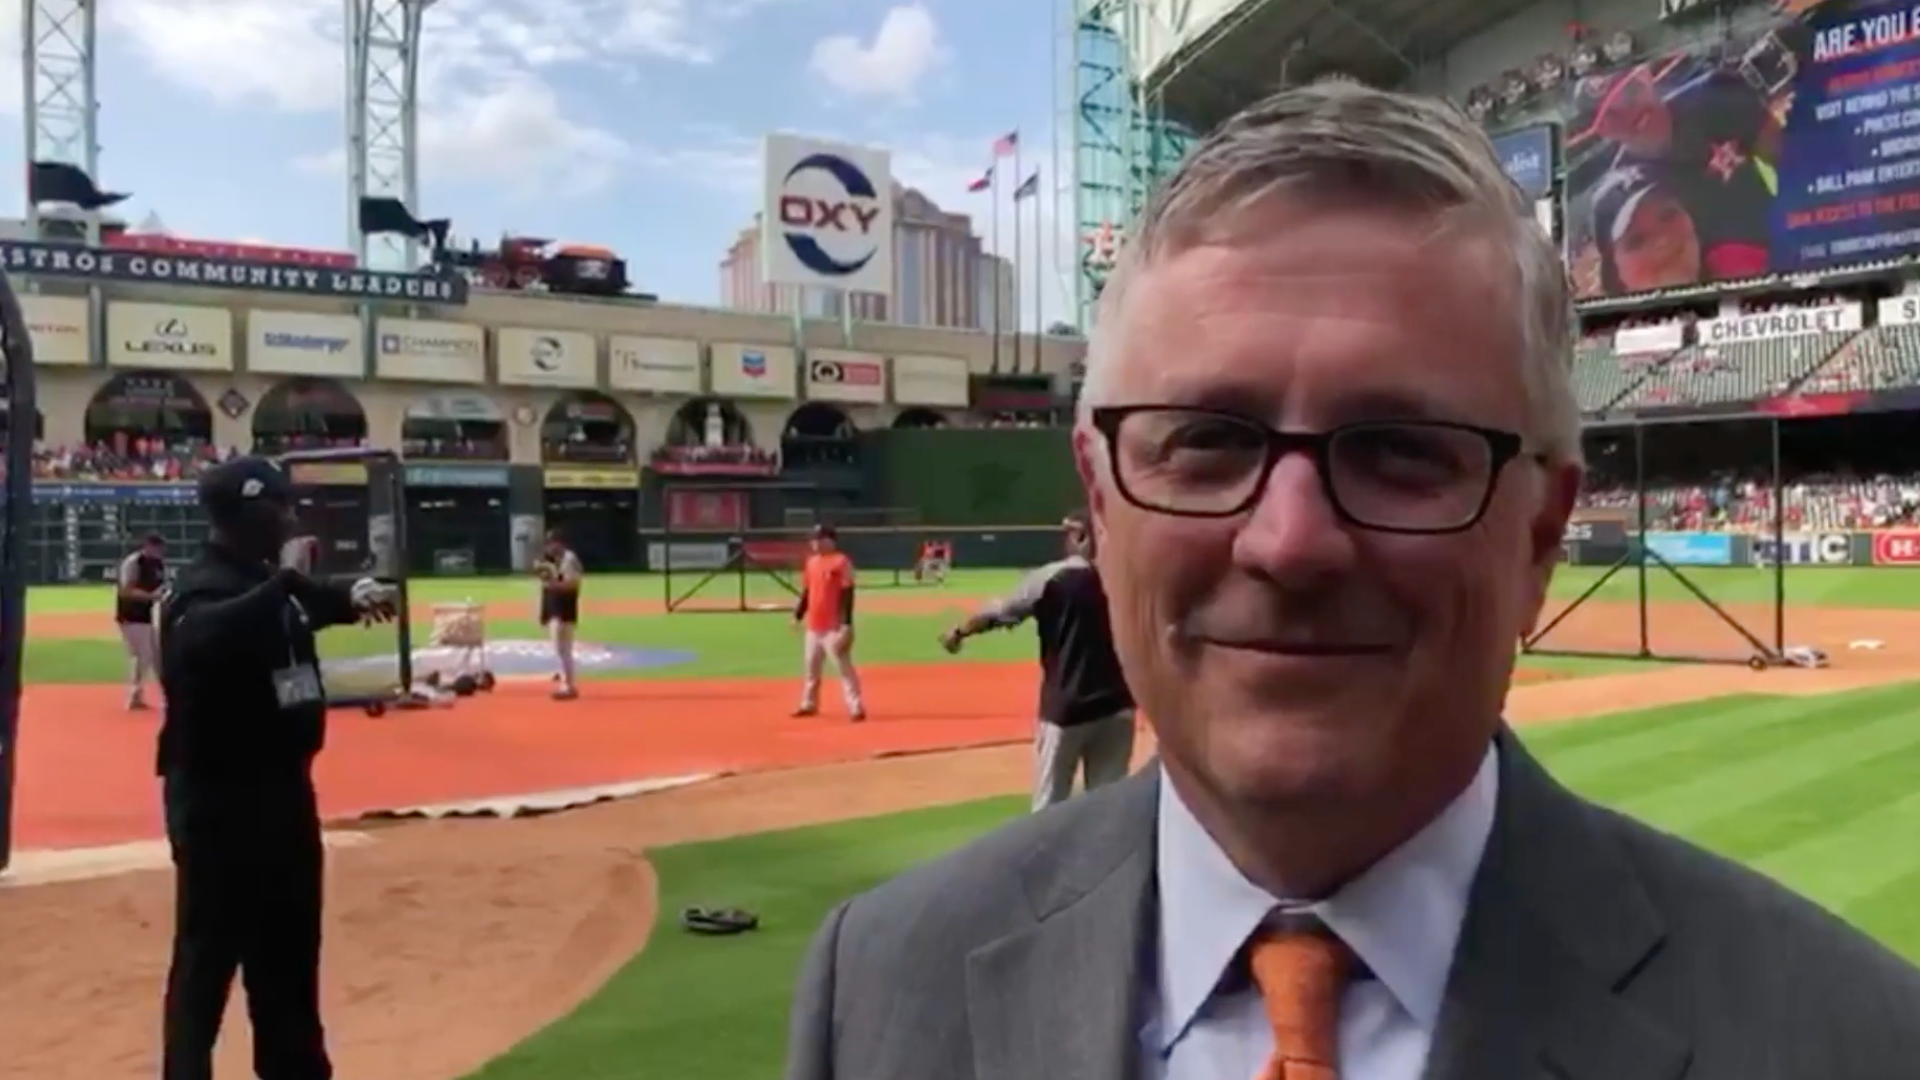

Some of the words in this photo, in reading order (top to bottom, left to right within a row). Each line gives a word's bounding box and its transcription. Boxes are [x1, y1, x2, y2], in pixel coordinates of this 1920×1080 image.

[1813, 22, 1857, 62] ARE
[1861, 10, 1906, 49] YOU
[779, 195, 880, 234] OXY
[129, 256, 319, 290] COMMUNITY
[331, 273, 453, 299] LEADERS
[1711, 308, 1843, 341] CHEVROLET
[124, 340, 218, 356] LEXUS
